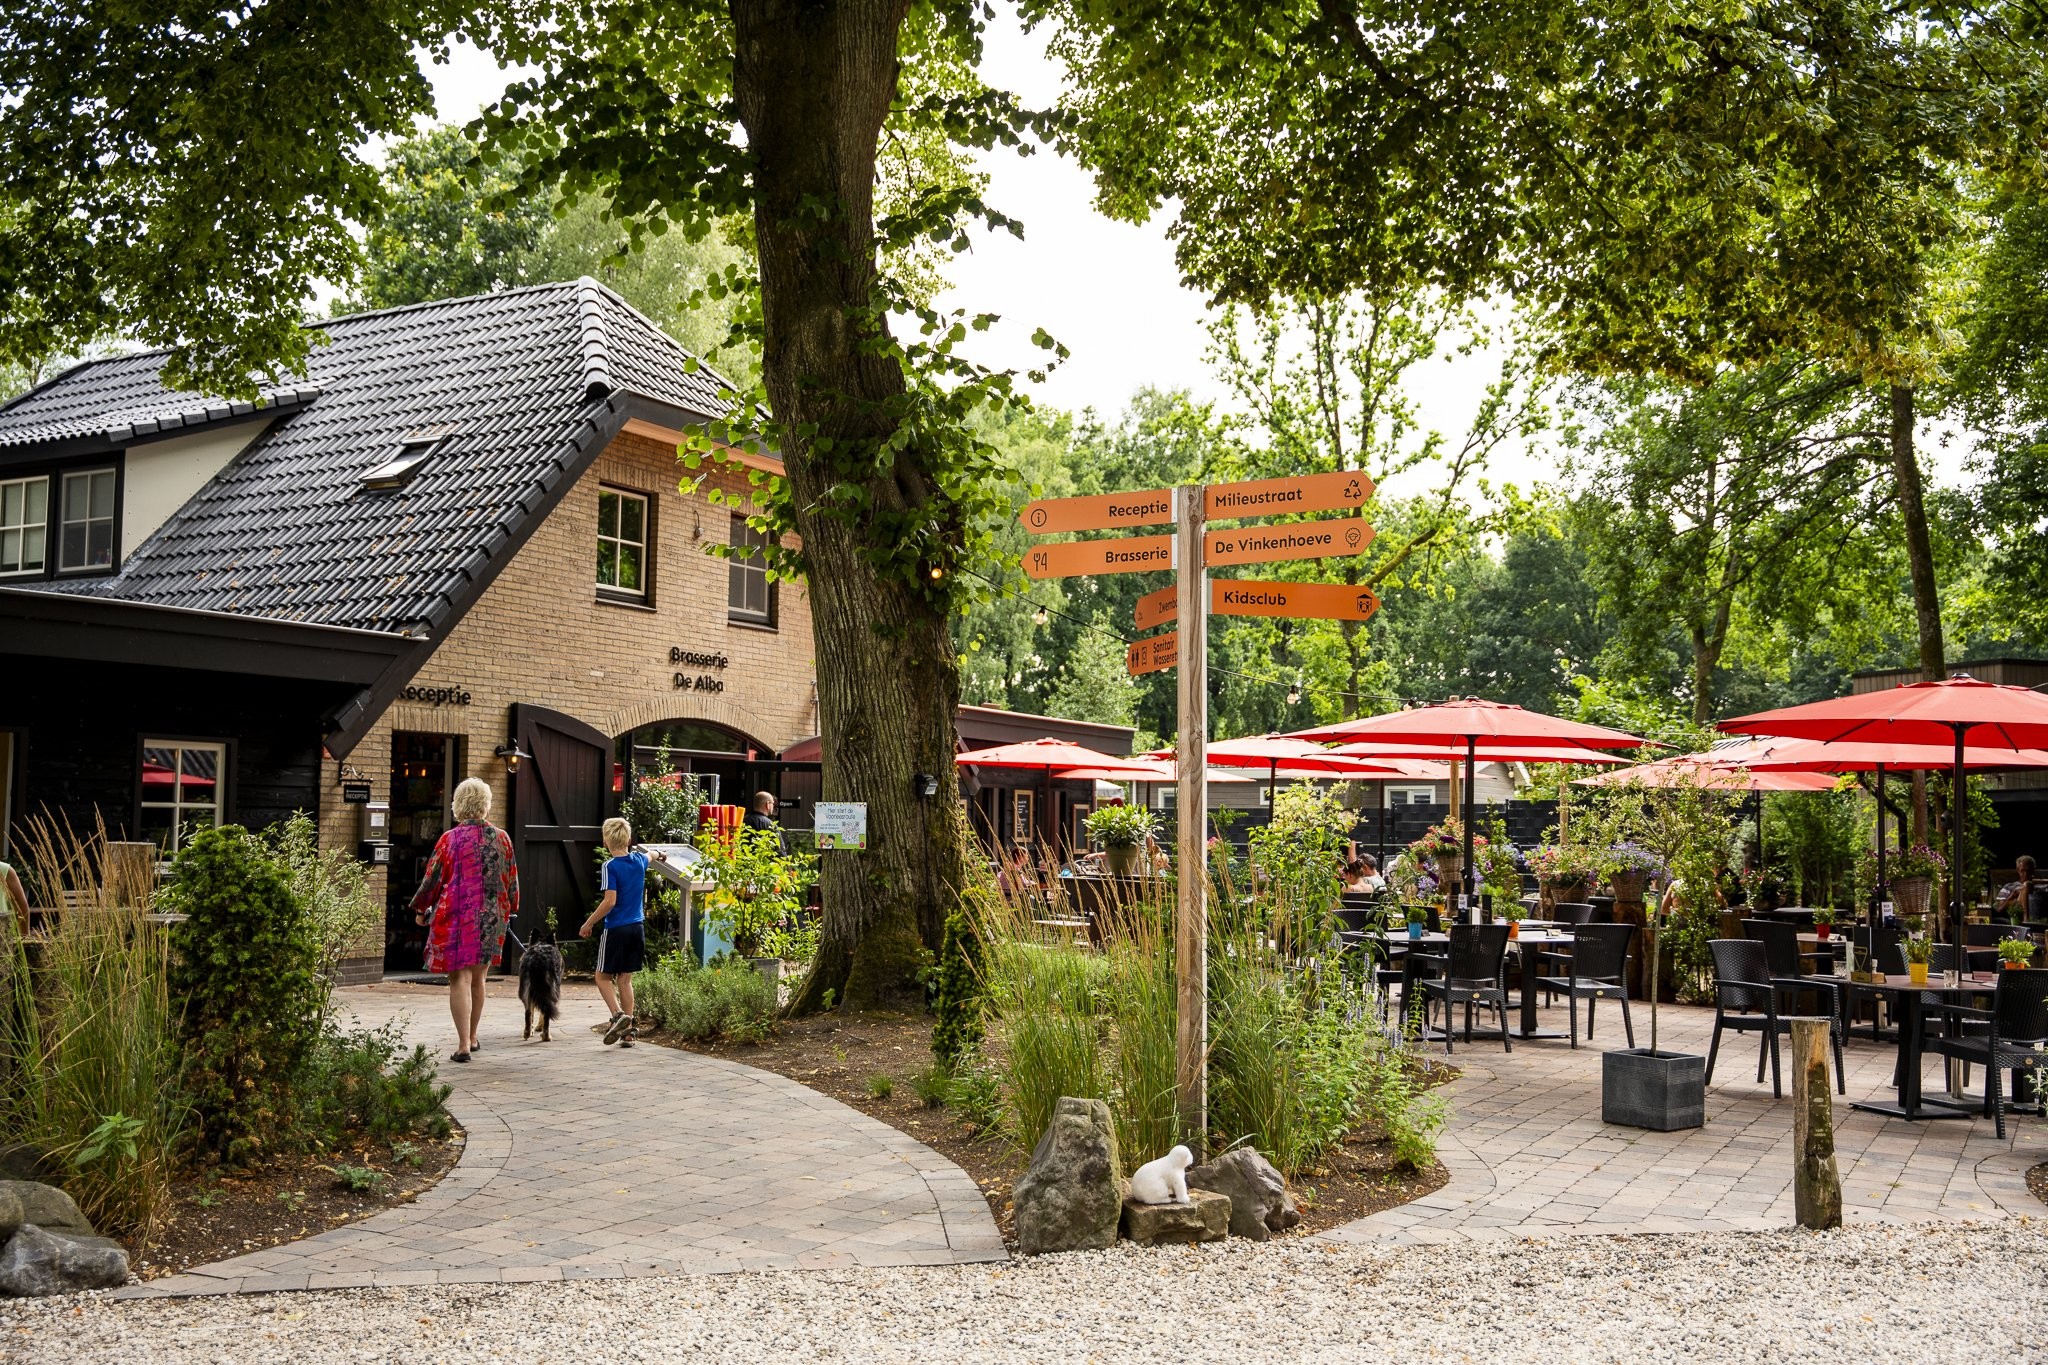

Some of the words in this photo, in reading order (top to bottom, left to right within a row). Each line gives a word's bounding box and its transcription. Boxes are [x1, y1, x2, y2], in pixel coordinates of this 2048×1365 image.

[1215, 488, 1302, 507] Milieustraat
[1109, 500, 1168, 518] Receptie
[1215, 541, 1233, 553] De
[1238, 534, 1331, 551] Vinkenhoeve
[1105, 546, 1168, 563] Brasserie
[1224, 591, 1287, 605] Kidsclub
[1153, 637, 1174, 653] Sanitair
[670, 646, 728, 668] Brasserie
[674, 672, 692, 688] De
[694, 675, 723, 691] Alba
